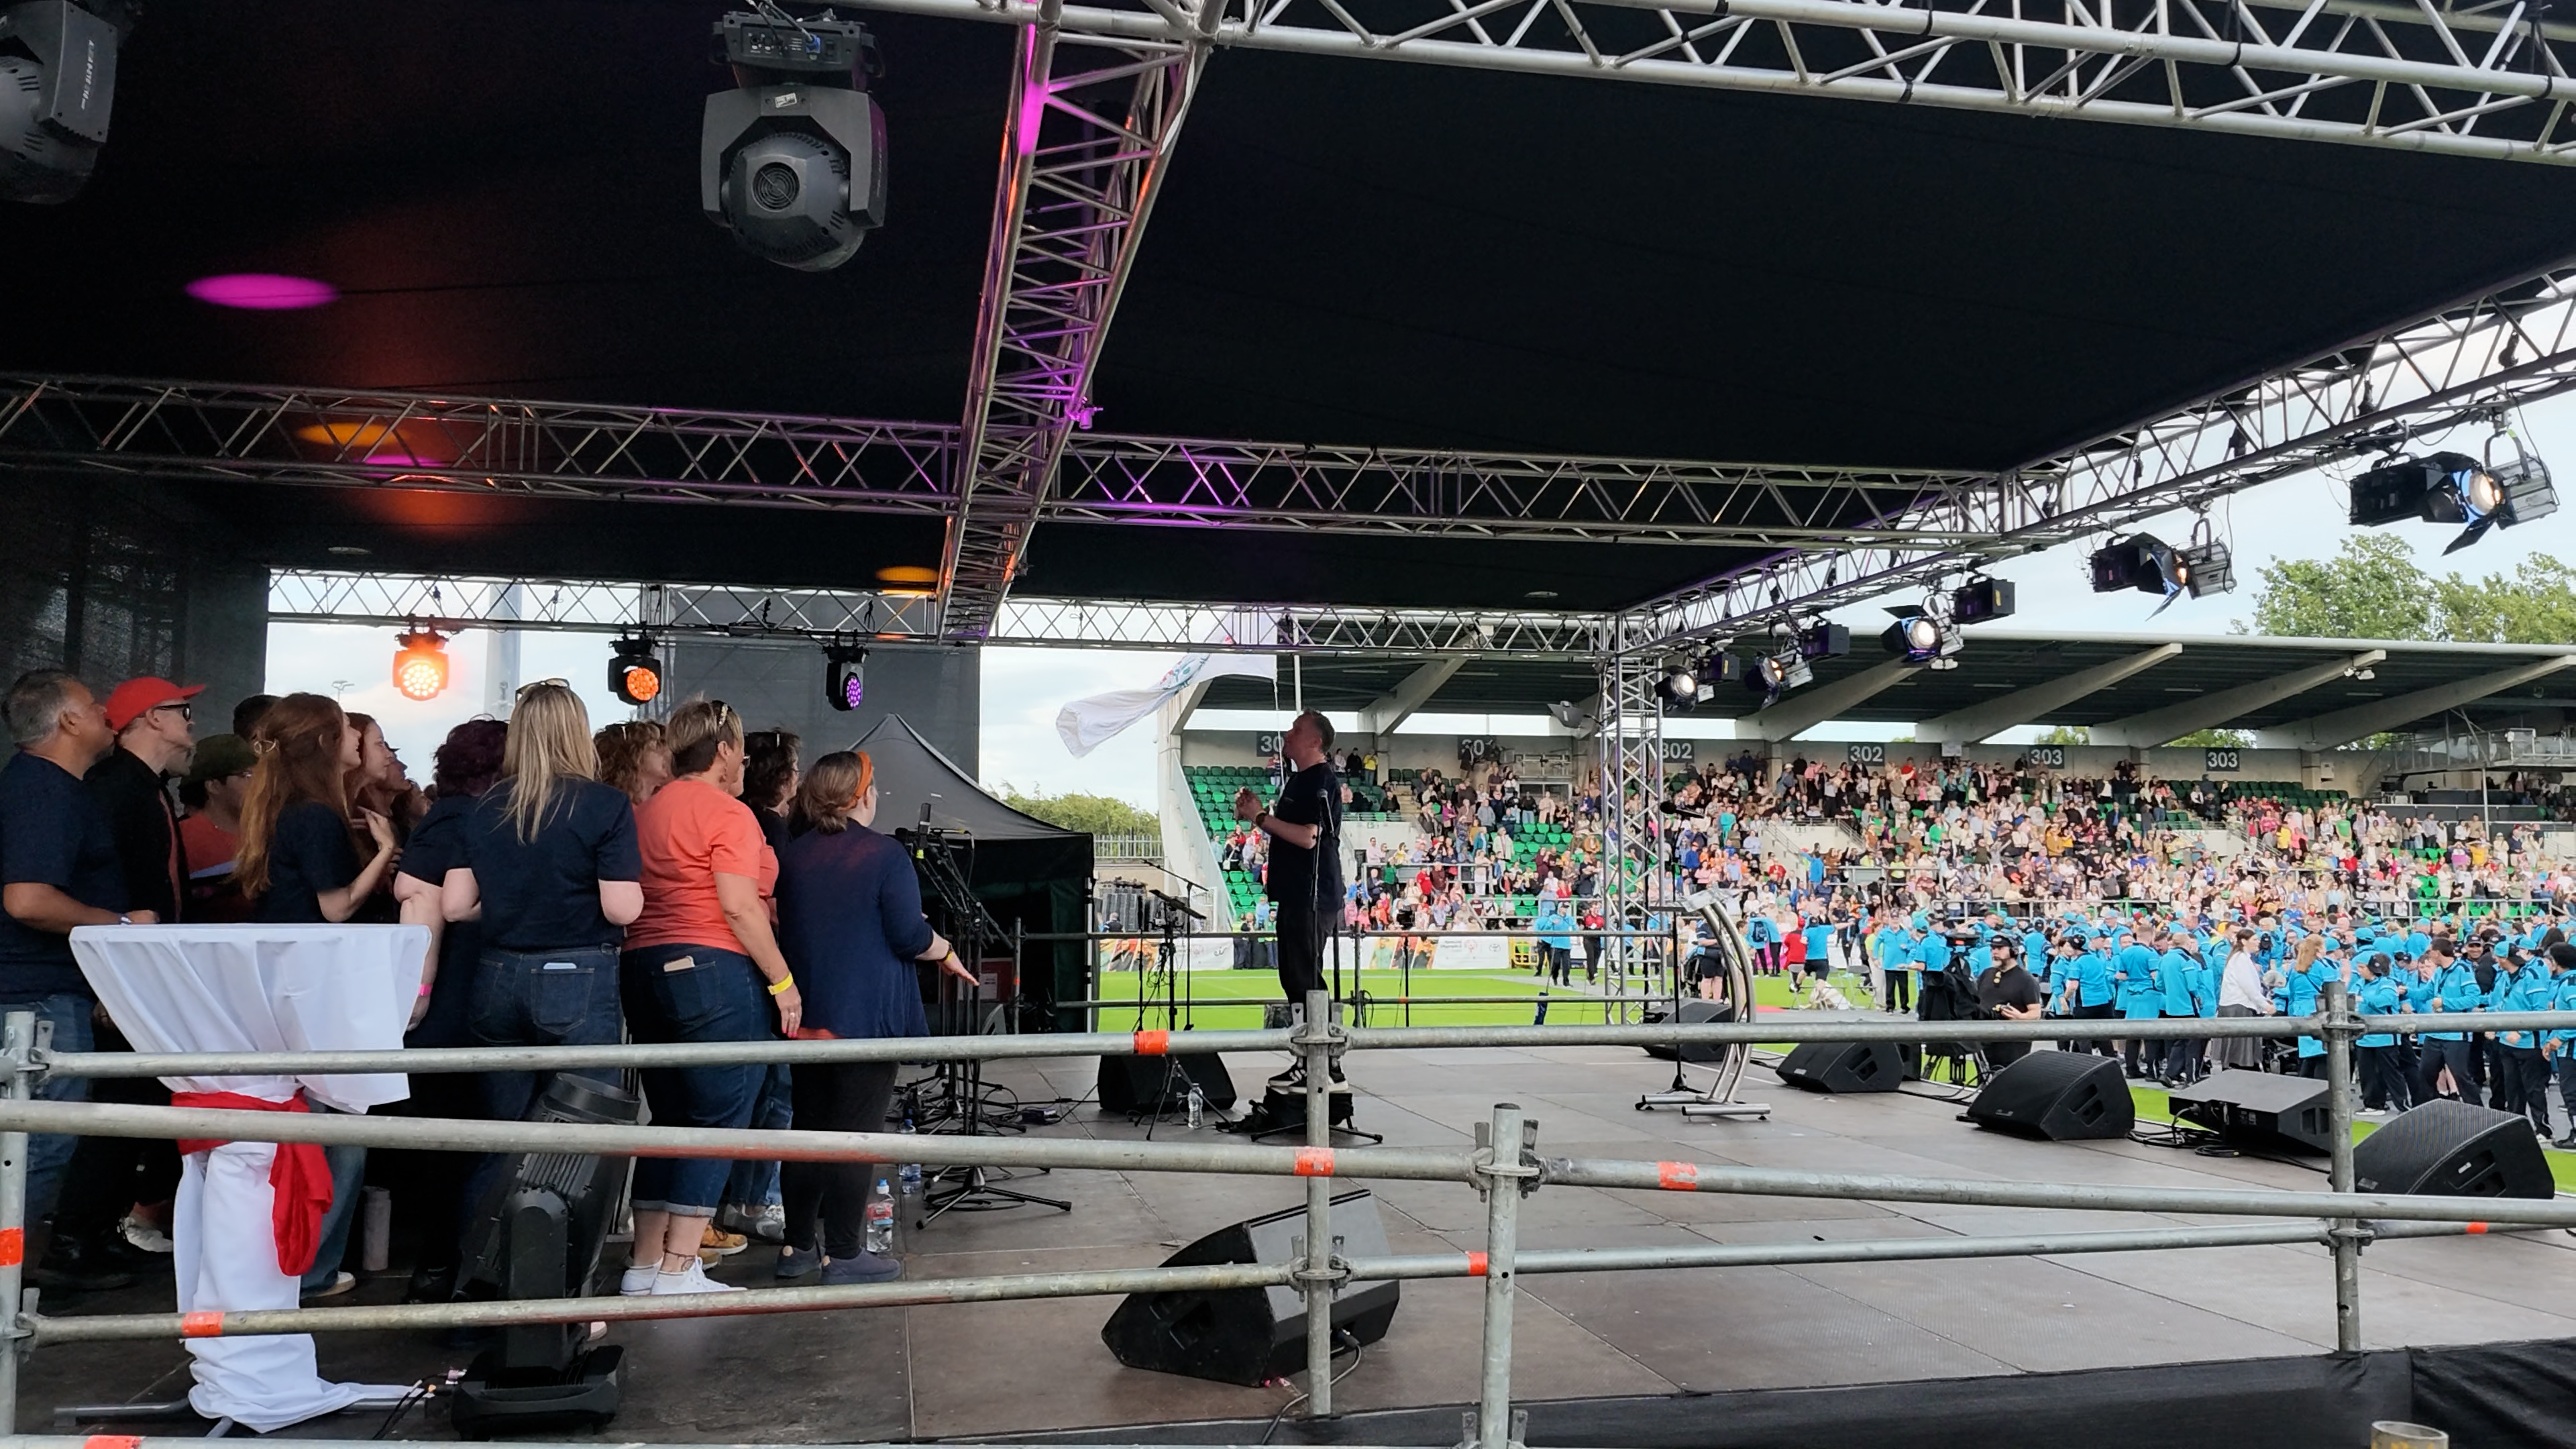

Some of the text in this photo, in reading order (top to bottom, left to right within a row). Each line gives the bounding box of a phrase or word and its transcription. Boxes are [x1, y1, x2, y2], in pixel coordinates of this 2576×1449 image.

[1850, 746, 1883, 762] 302
[2031, 749, 2063, 765] 303
[2208, 751, 2238, 768] 303
